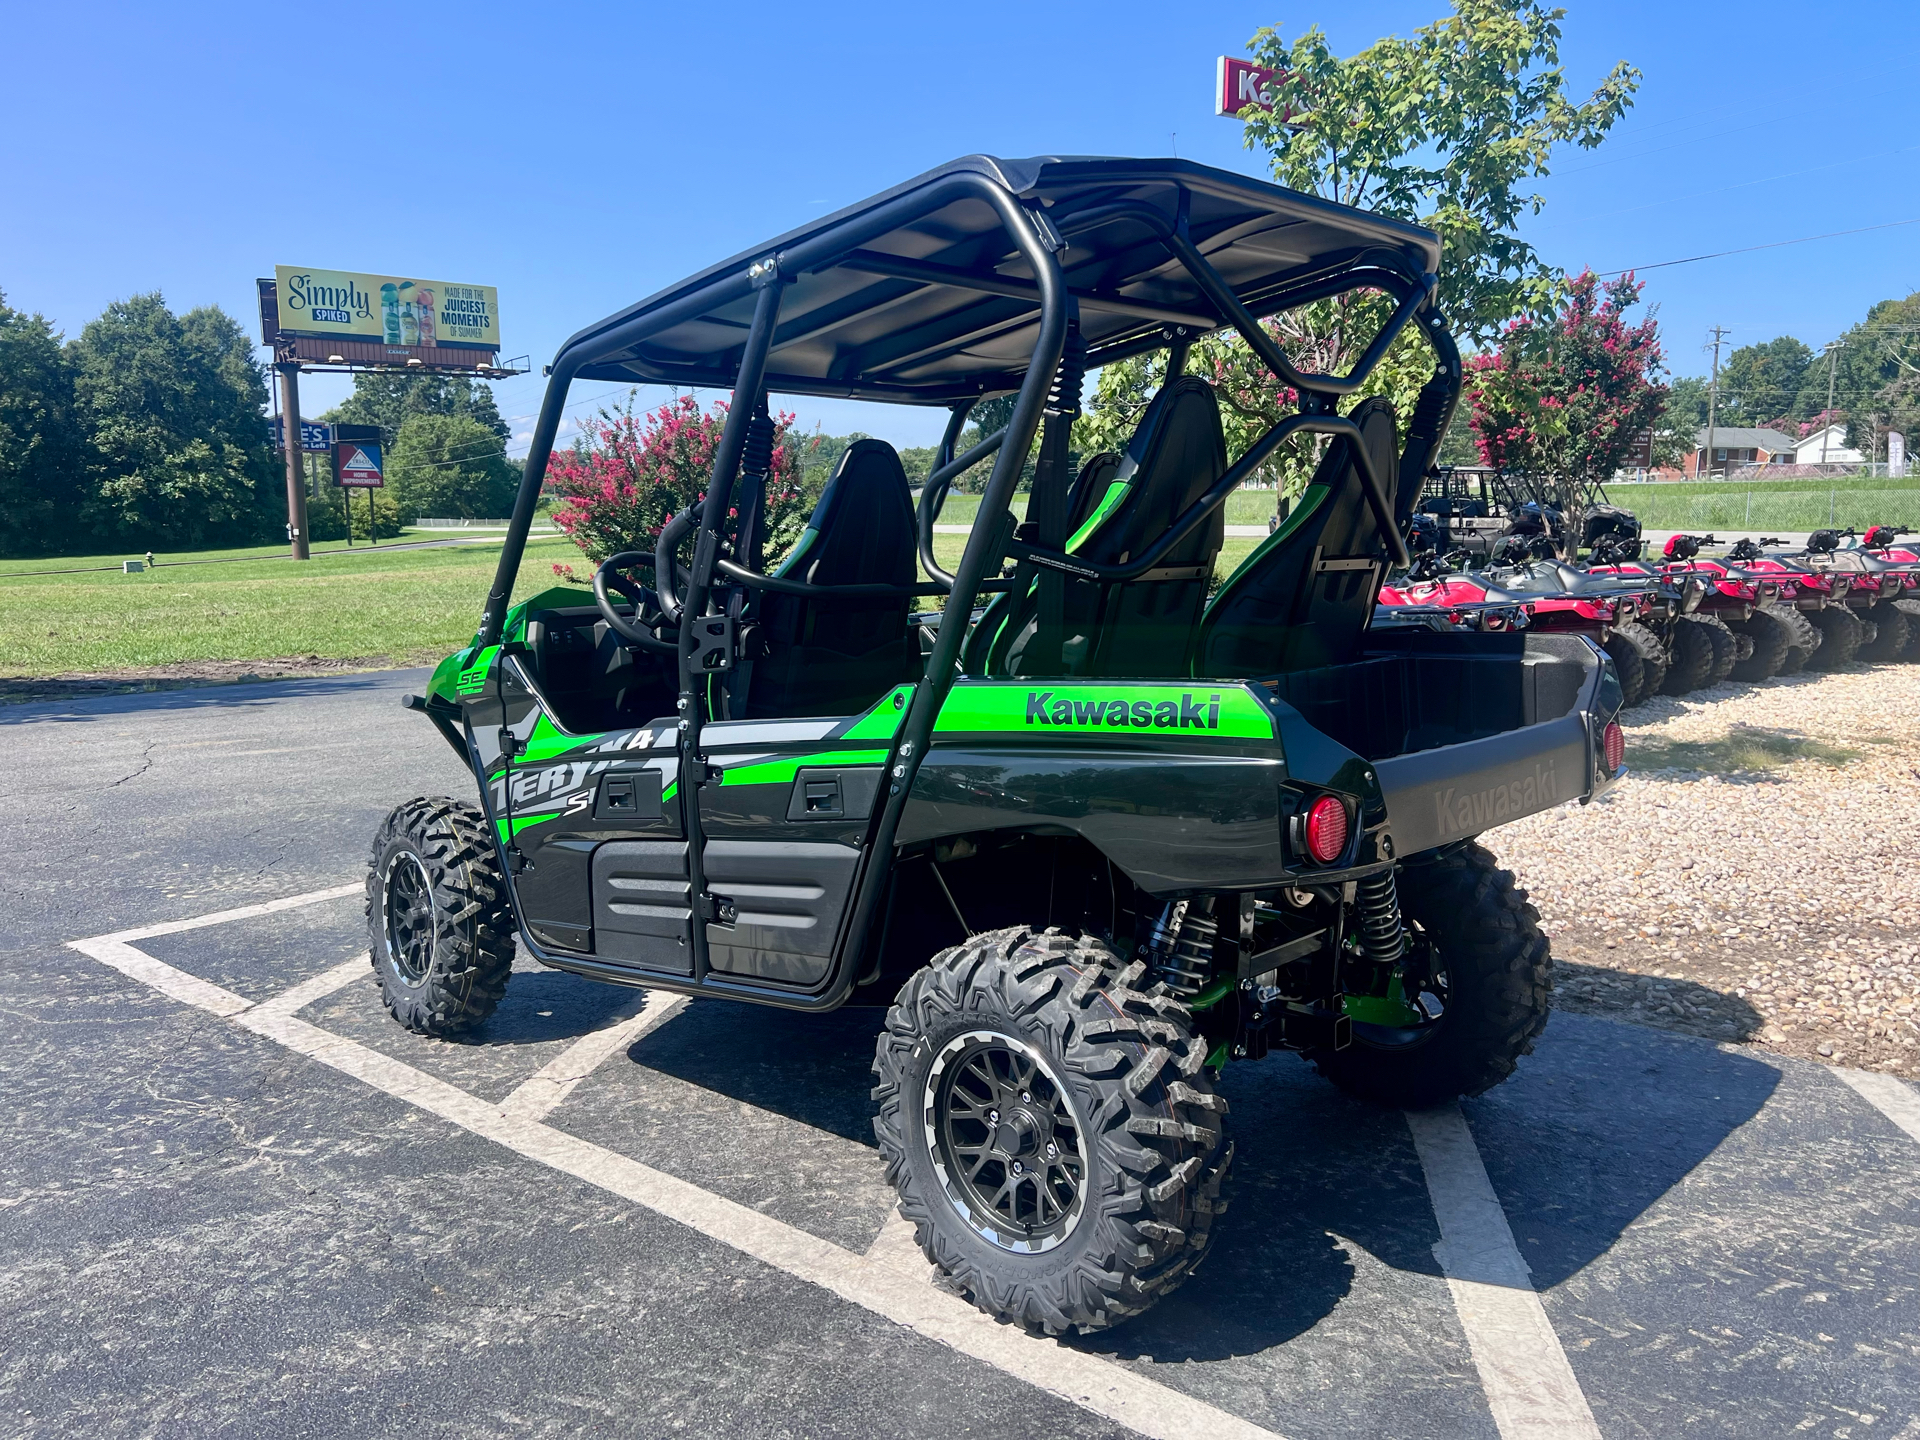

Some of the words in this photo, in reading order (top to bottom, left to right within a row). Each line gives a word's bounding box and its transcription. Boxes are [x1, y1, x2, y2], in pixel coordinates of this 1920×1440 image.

[288, 274, 374, 320] Simply
[444, 286, 460, 298] MADE
[462, 288, 472, 299] FOR
[474, 289, 484, 301] THE
[444, 298, 485, 314] JUICIEST
[316, 309, 348, 323] SPIKED
[441, 311, 490, 328] MOMENTS
[450, 325, 457, 337] OF
[458, 326, 483, 338] SUMMER
[342, 478, 381, 486] IMPROVEMENTS
[457, 671, 486, 686] SE
[1025, 691, 1220, 730] Kawasaki
[1435, 759, 1558, 837] Kawasaki
